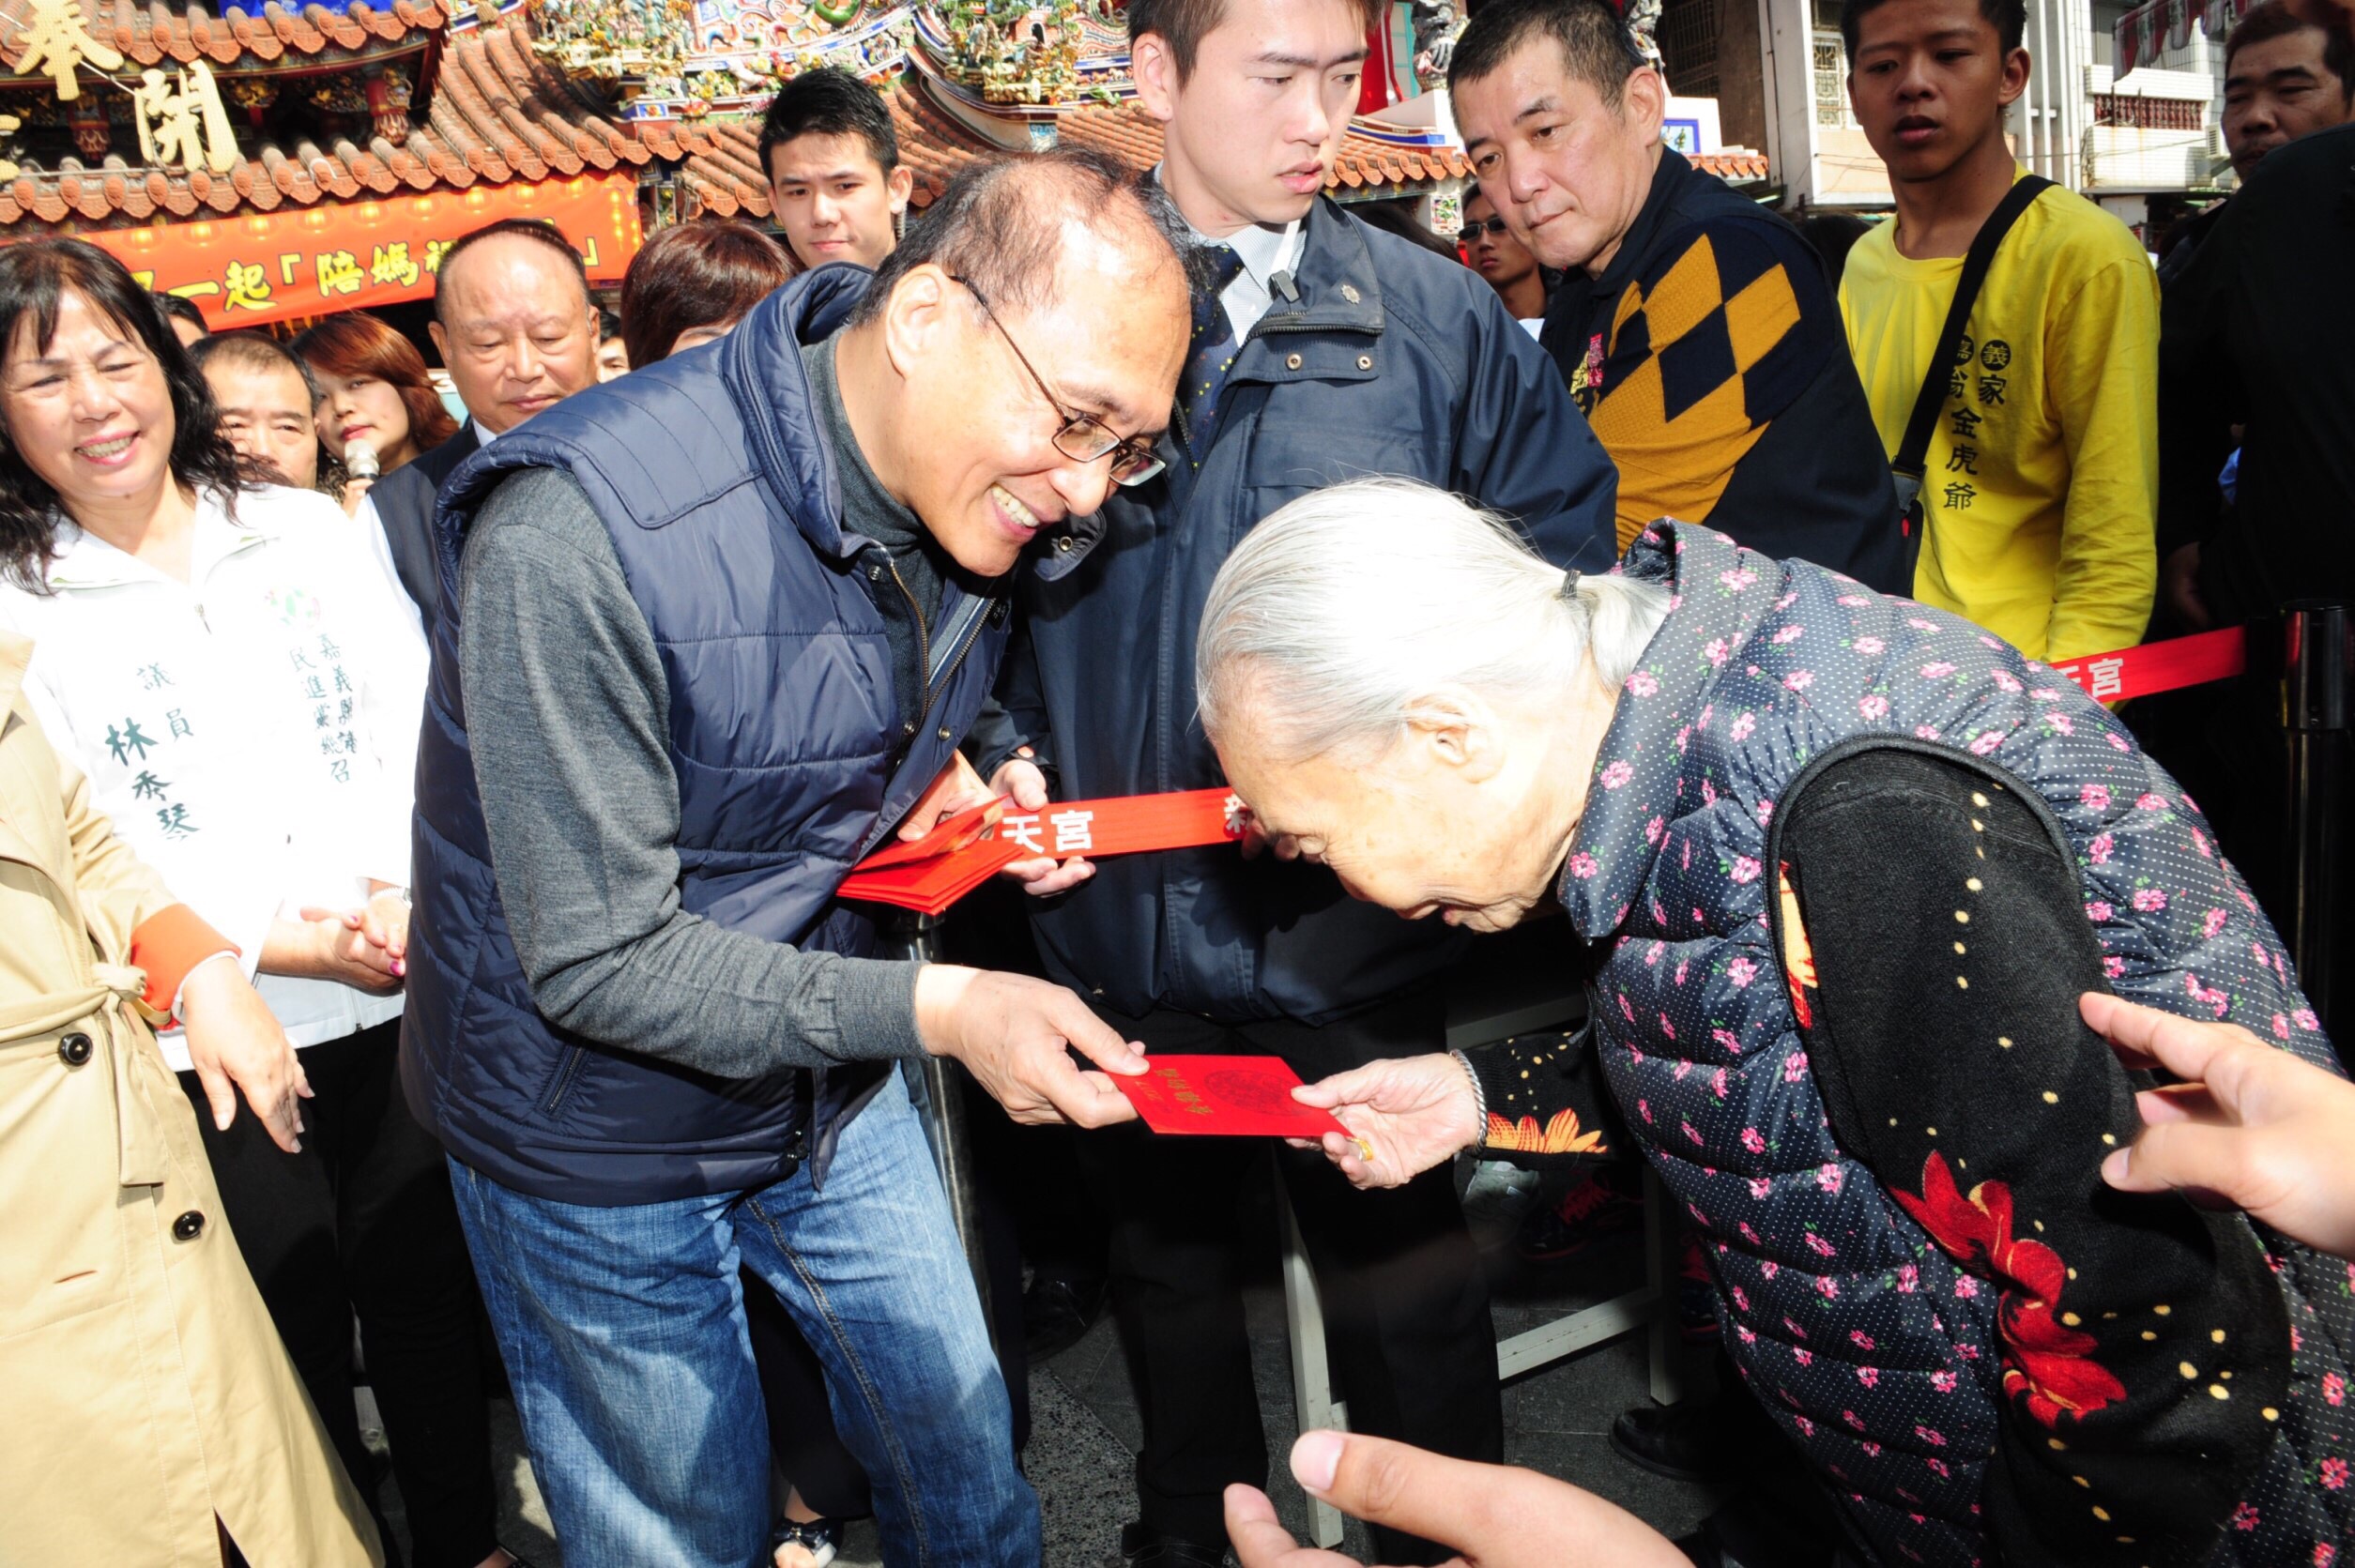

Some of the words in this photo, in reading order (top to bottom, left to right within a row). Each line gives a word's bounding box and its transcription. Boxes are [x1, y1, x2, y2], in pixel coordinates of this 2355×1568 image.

[1943, 406, 1983, 511] 金虎爺
[1001, 810, 1094, 855] 天宮
